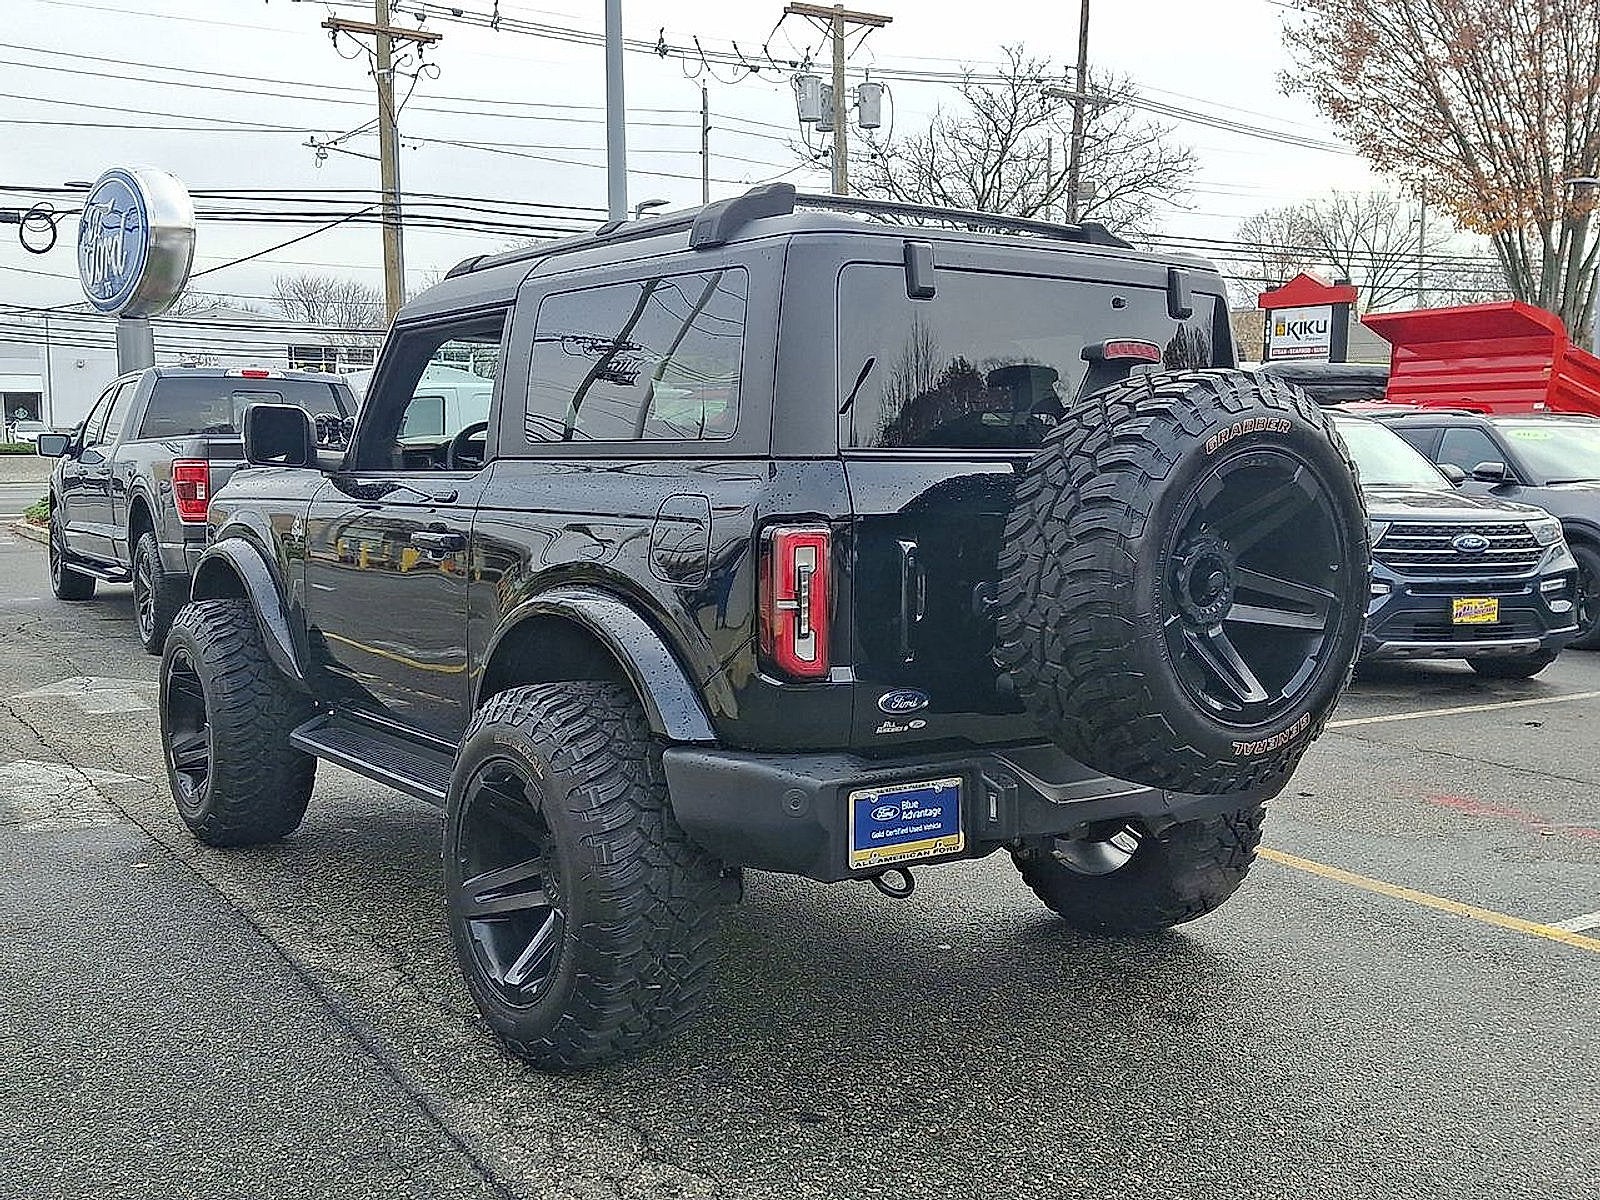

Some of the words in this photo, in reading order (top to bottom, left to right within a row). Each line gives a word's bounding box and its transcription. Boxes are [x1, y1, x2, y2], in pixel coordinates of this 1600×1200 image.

[82, 198, 128, 288] Ford
[1286, 319, 1328, 341] KIKU
[1205, 416, 1292, 455] GRABBER
[891, 694, 919, 709] Ford
[1232, 711, 1311, 756] GENERAL
[901, 800, 919, 811] Blue
[901, 807, 942, 821] Advantage
[871, 830, 885, 839] Gold
[885, 826, 909, 837] Certified
[909, 825, 923, 833] Used
[924, 821, 942, 831] Vehicle
[854, 859, 875, 868] ALL
[877, 849, 931, 864] AMERICAN
[932, 845, 960, 856] FORD
